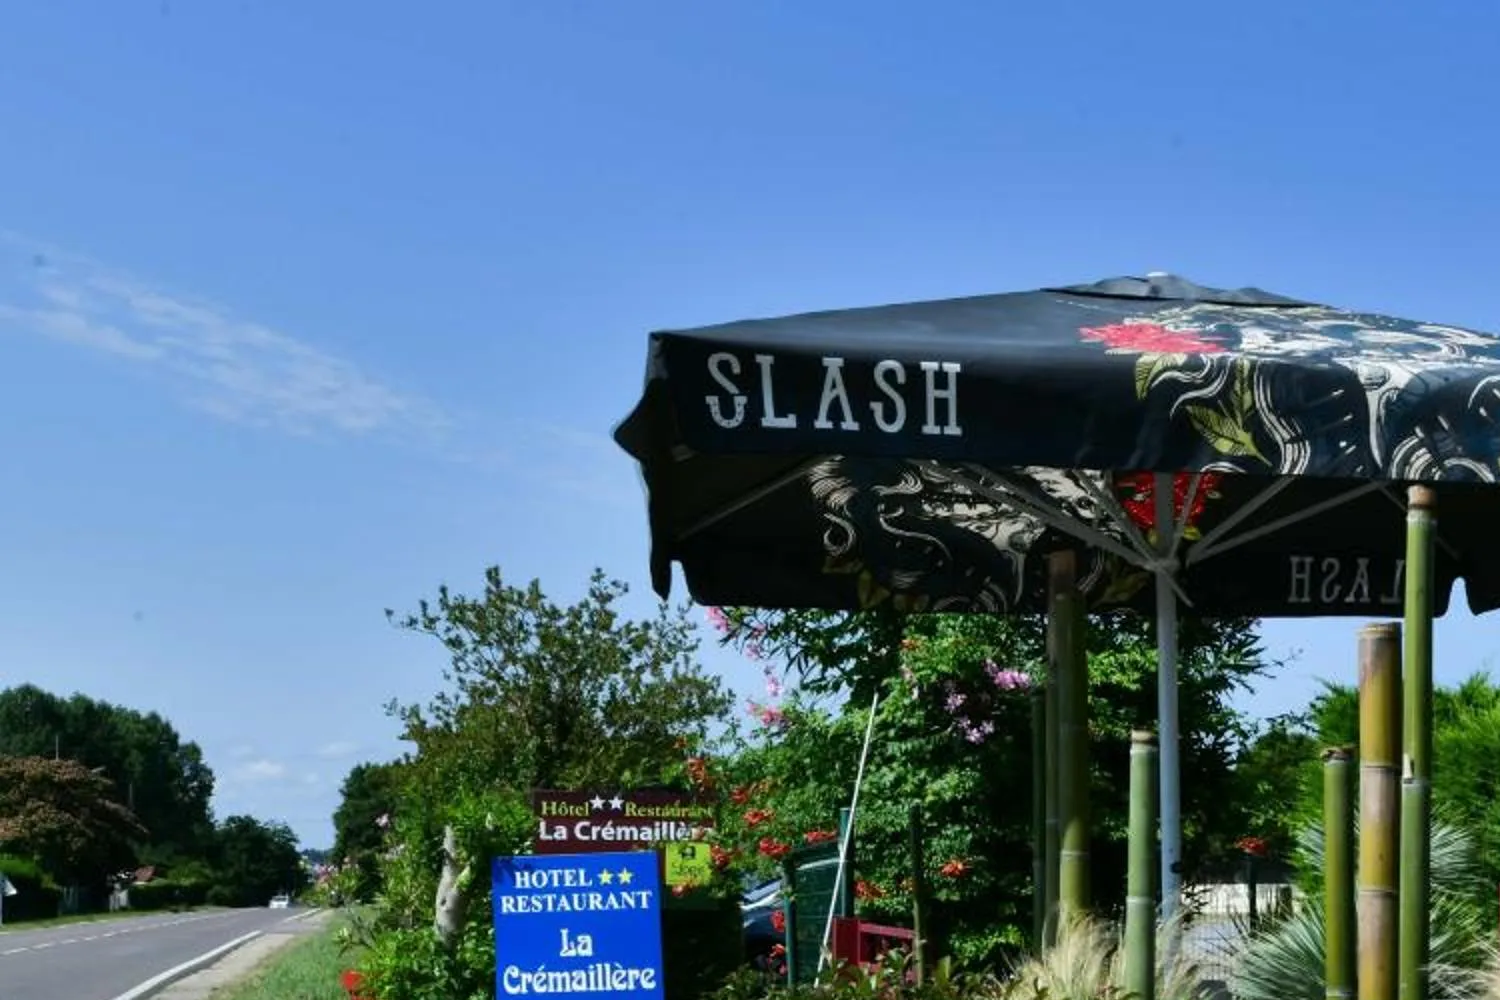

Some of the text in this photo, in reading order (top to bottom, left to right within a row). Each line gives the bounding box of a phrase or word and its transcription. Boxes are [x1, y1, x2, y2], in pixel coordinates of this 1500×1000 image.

[705, 352, 963, 436] SLASH
[541, 801, 713, 817] Hôtel Restaurant
[539, 820, 568, 841] La
[514, 869, 593, 889] HOTEL
[500, 891, 653, 914] RESTAURANT
[560, 928, 593, 957] La
[503, 962, 657, 995] Crémaillère
